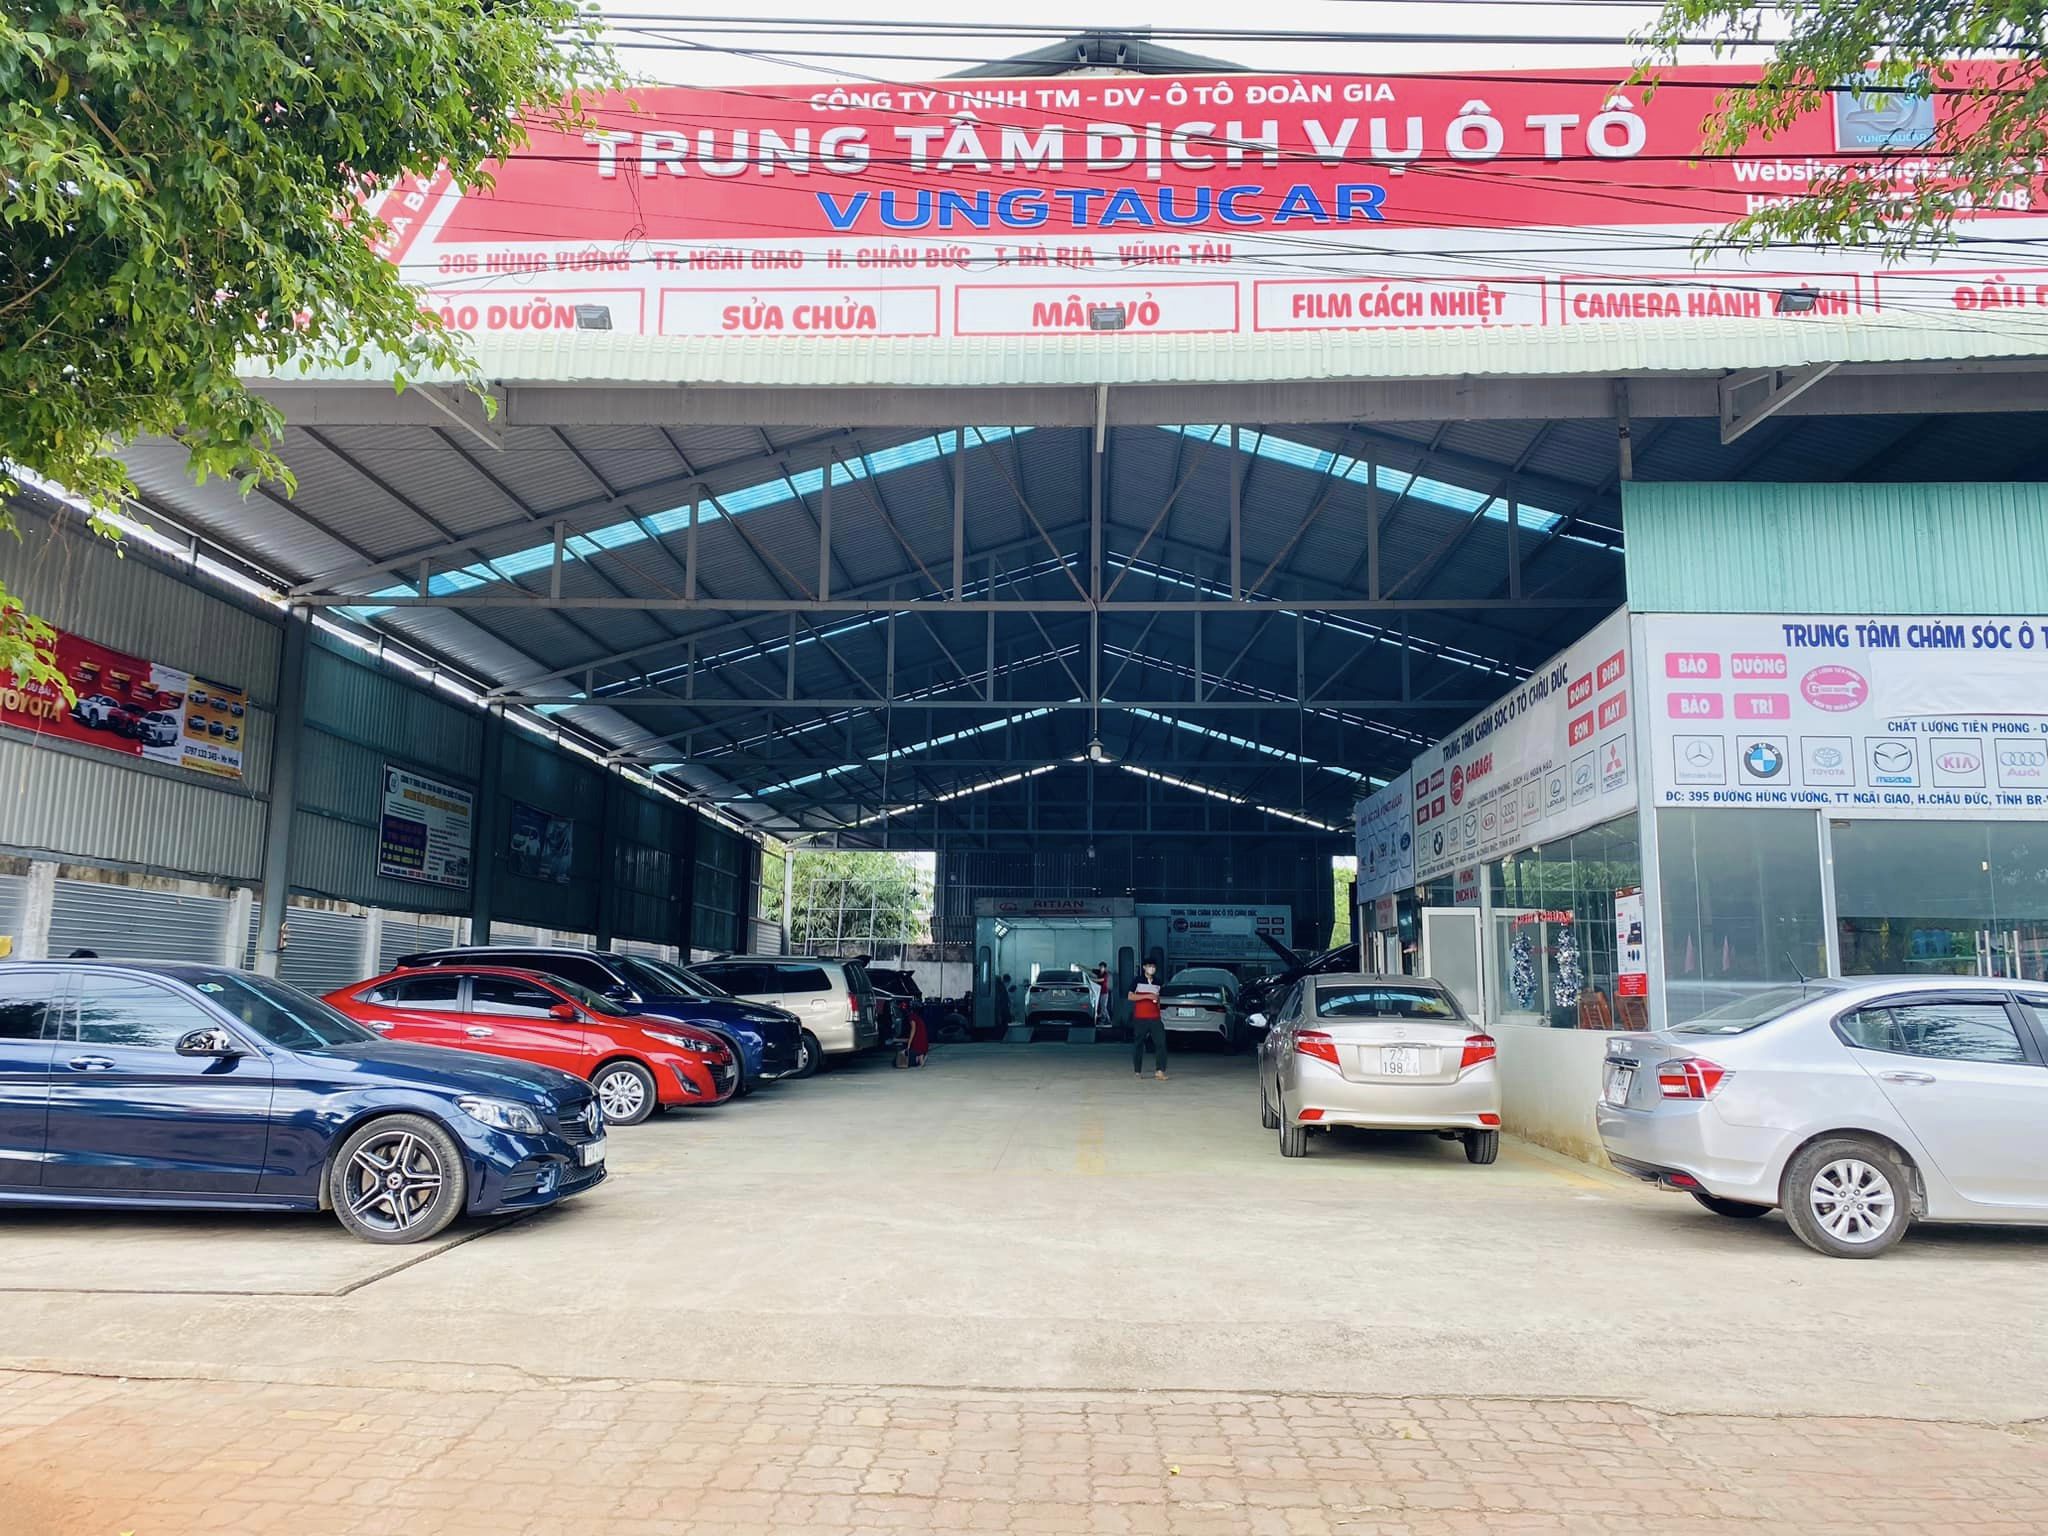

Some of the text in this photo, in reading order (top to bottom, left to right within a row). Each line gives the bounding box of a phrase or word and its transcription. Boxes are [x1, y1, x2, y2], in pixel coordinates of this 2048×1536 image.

[810, 87, 892, 111] CÔNG
[900, 91, 938, 110] TY
[942, 89, 1032, 109] TNHH
[1035, 88, 1080, 108] TM
[1103, 87, 1146, 106] DV
[1165, 81, 1188, 105] Ô
[1193, 81, 1235, 105] TÔ
[1245, 80, 1333, 105] ĐOÀN
[1343, 83, 1396, 102] GIA
[583, 94, 1647, 181] TRUNG TÂM DỊCH VỤ Ô TÔ
[814, 182, 1389, 231] VUNGTAUCAR
[486, 247, 548, 272] HÙNG
[554, 249, 631, 272] VƯƠNG
[752, 250, 804, 270] GIAO
[826, 248, 848, 269] H.
[857, 244, 918, 269] CHÂU
[926, 243, 971, 268] ĐỨC
[1018, 240, 1048, 266] BÀ
[1118, 240, 1180, 267] VŨNG
[1188, 240, 1232, 264] TÀU
[1292, 283, 1506, 324] FILM CÁCH NHIỆT
[1573, 283, 1849, 318] CAMERA HÀNH TNH
[1951, 274, 2026, 311] ĐẦU
[486, 296, 594, 331] DƯỠN
[721, 297, 784, 331] SỬA
[1782, 623, 1849, 648] TRUNG
[1855, 619, 1900, 648] TÂM
[1906, 620, 1966, 648] CHĂM
[1971, 620, 2013, 649] SÓC
[2017, 620, 2035, 649] Ô
[1887, 717, 1917, 733] CHẤT
[1921, 720, 1959, 735] LƯỢNG
[1961, 718, 1988, 733] TIÊN
[1992, 721, 2030, 733] PHONG
[1465, 751, 1494, 785] GARAGE
[1943, 756, 1974, 769] KIA
[1688, 791, 1710, 802] 395
[1713, 789, 1752, 803] ĐƯỜNG
[1835, 792, 1849, 803] TT
[1883, 793, 1914, 806] GIAO,
[2026, 794, 2048, 806] BR-
